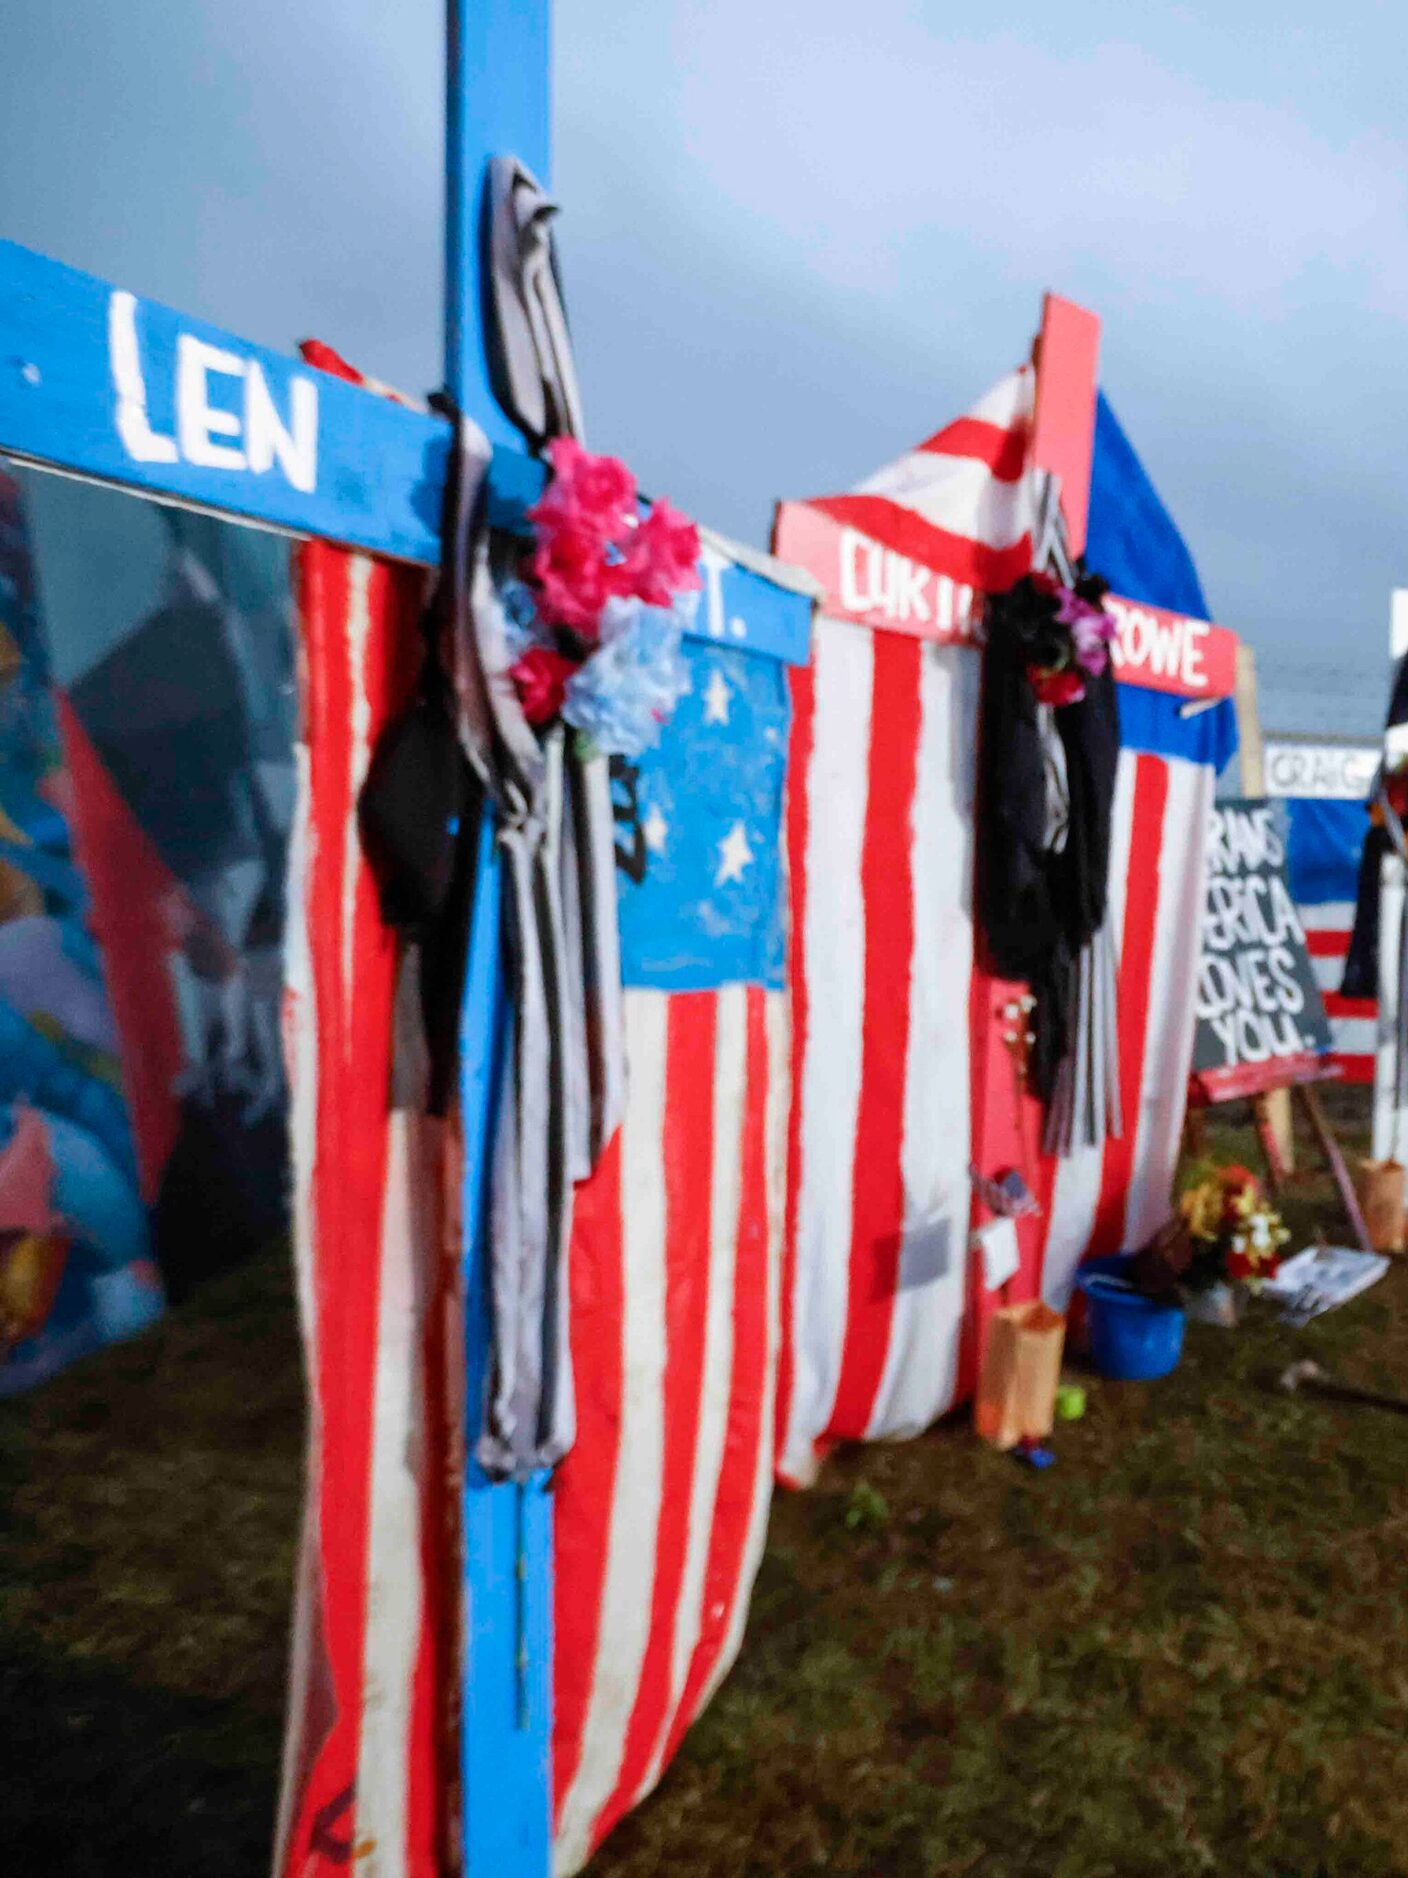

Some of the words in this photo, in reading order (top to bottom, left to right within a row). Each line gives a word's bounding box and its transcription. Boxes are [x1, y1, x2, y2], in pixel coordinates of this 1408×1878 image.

[110, 290, 319, 493] LEN
[1198, 874, 1305, 949] ERICA
[1196, 947, 1304, 1018] LOVES
